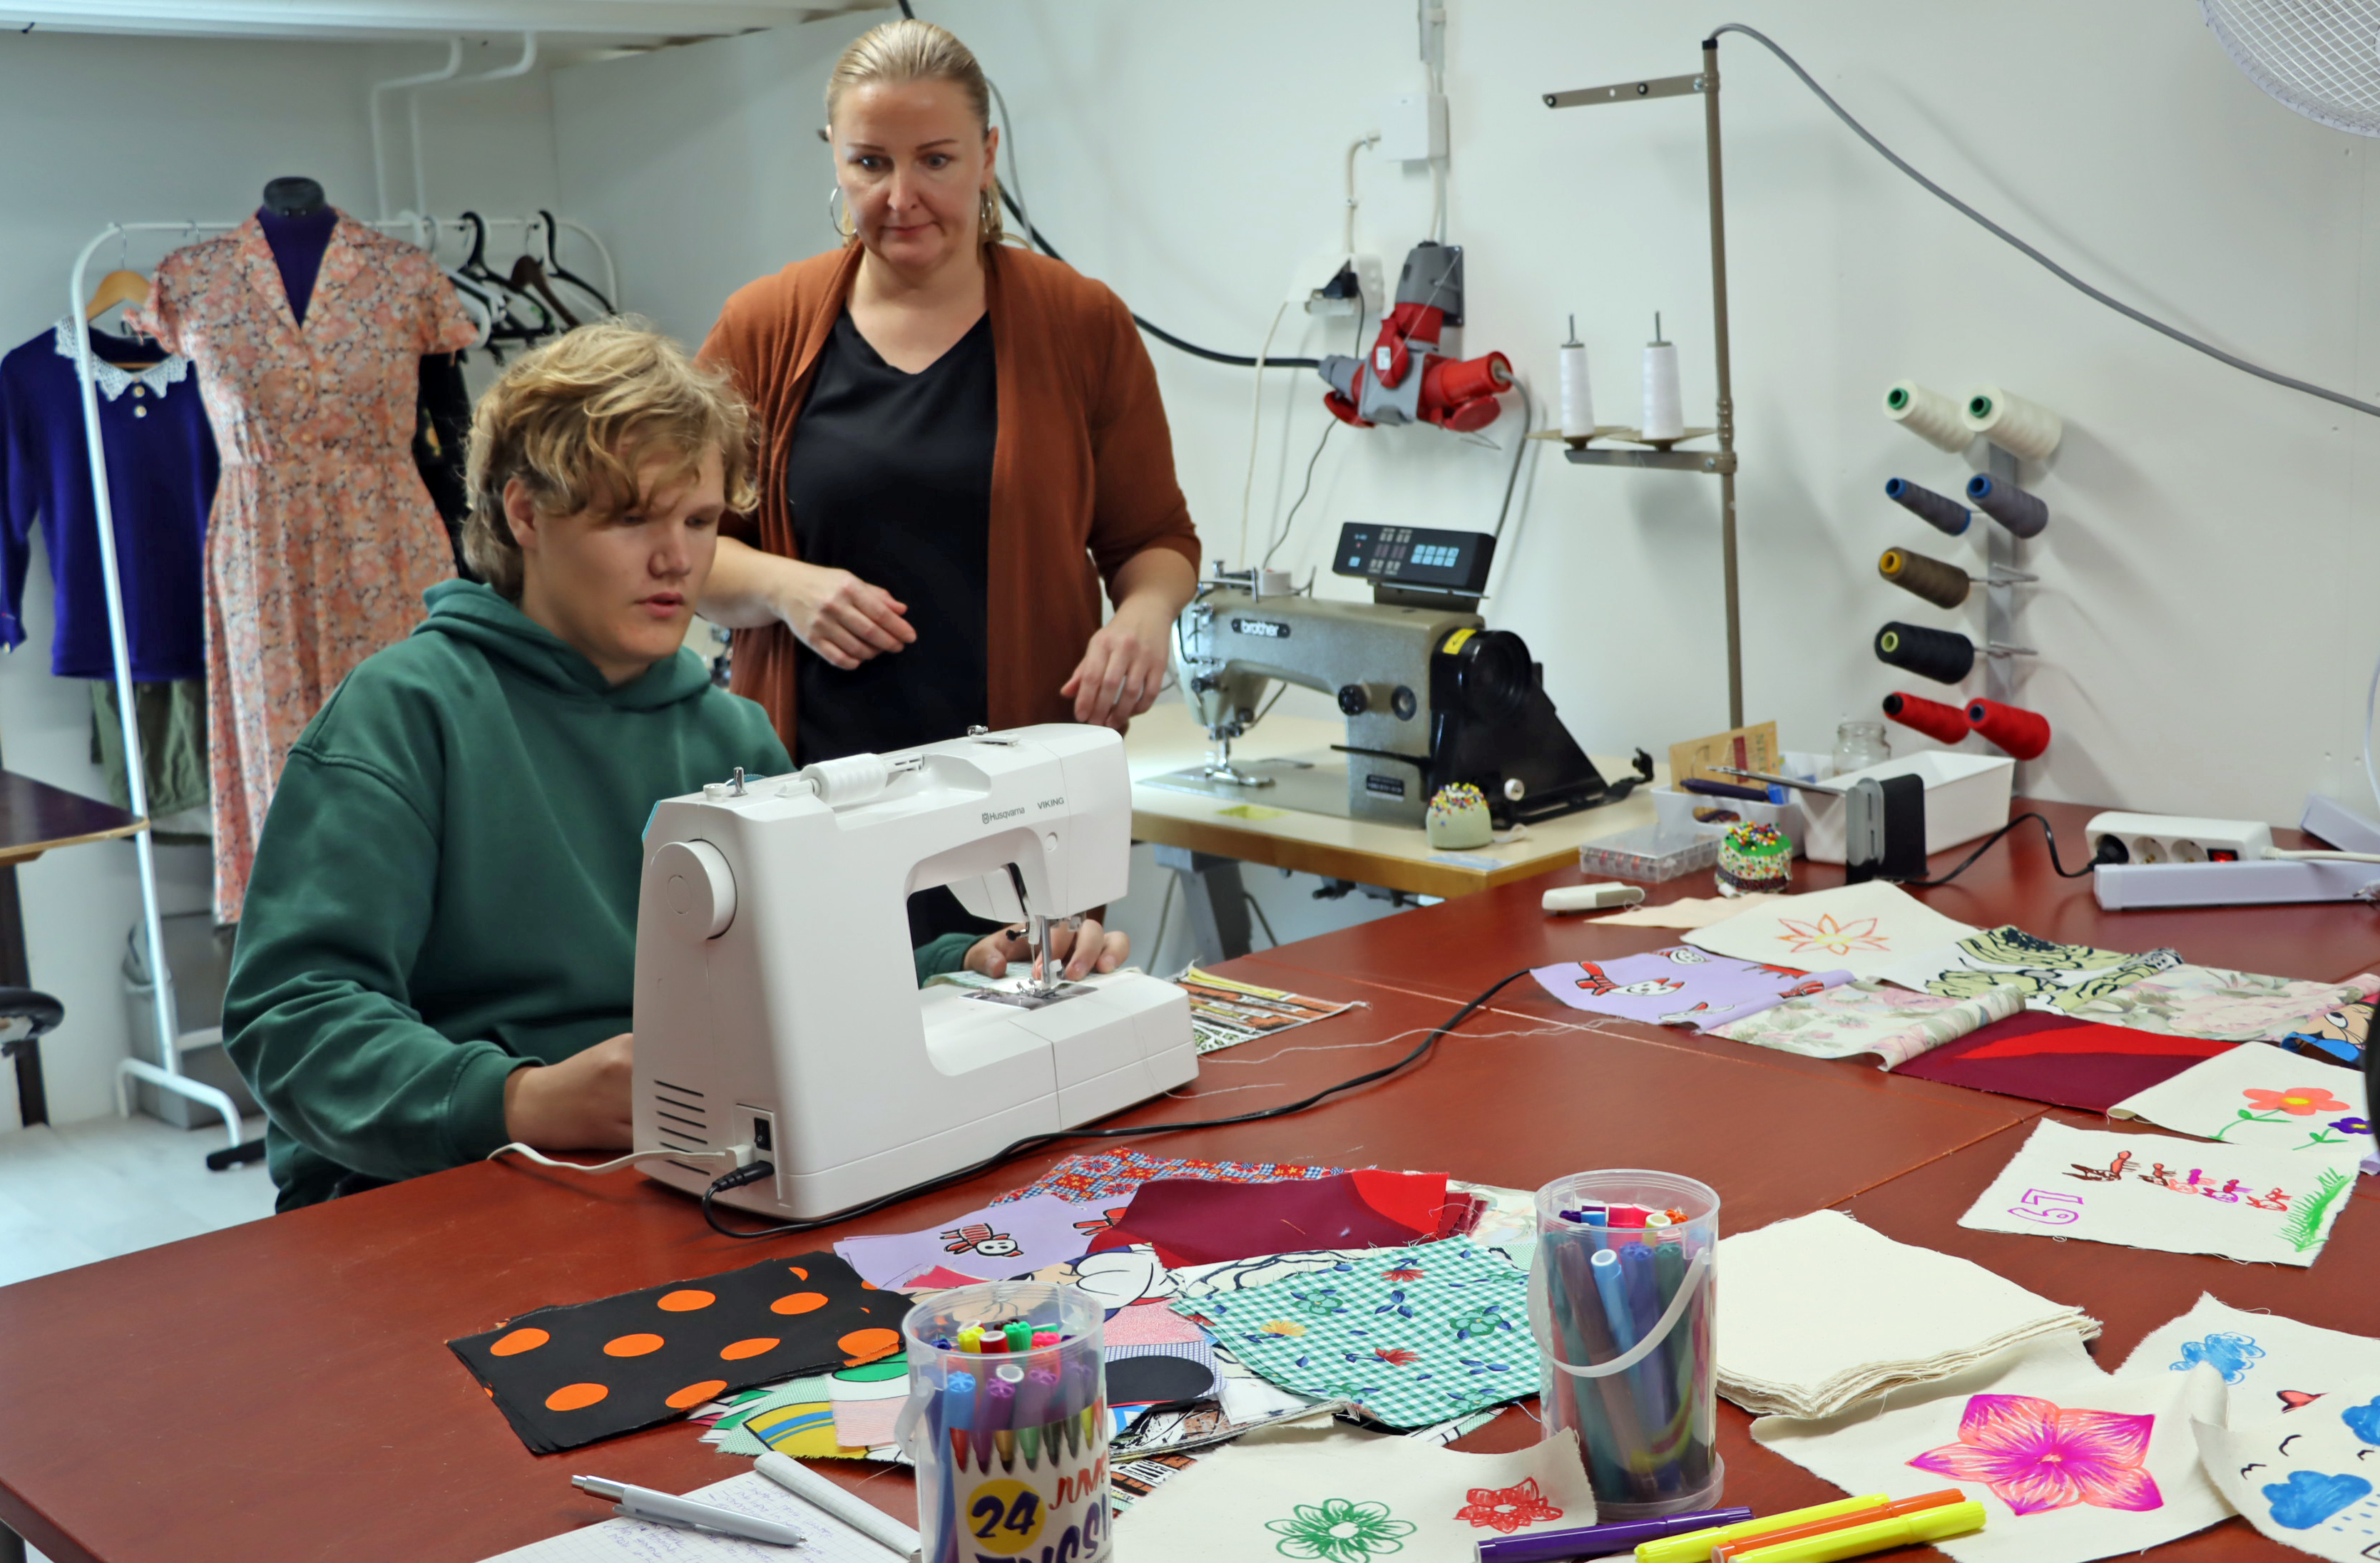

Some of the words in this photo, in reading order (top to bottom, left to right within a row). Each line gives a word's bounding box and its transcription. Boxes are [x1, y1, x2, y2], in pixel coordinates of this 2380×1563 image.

[1240, 619, 1280, 637] brother
[990, 806, 1026, 821] Husqvarna
[1037, 796, 1065, 809] VIKING
[971, 1490, 1039, 1539] 24
